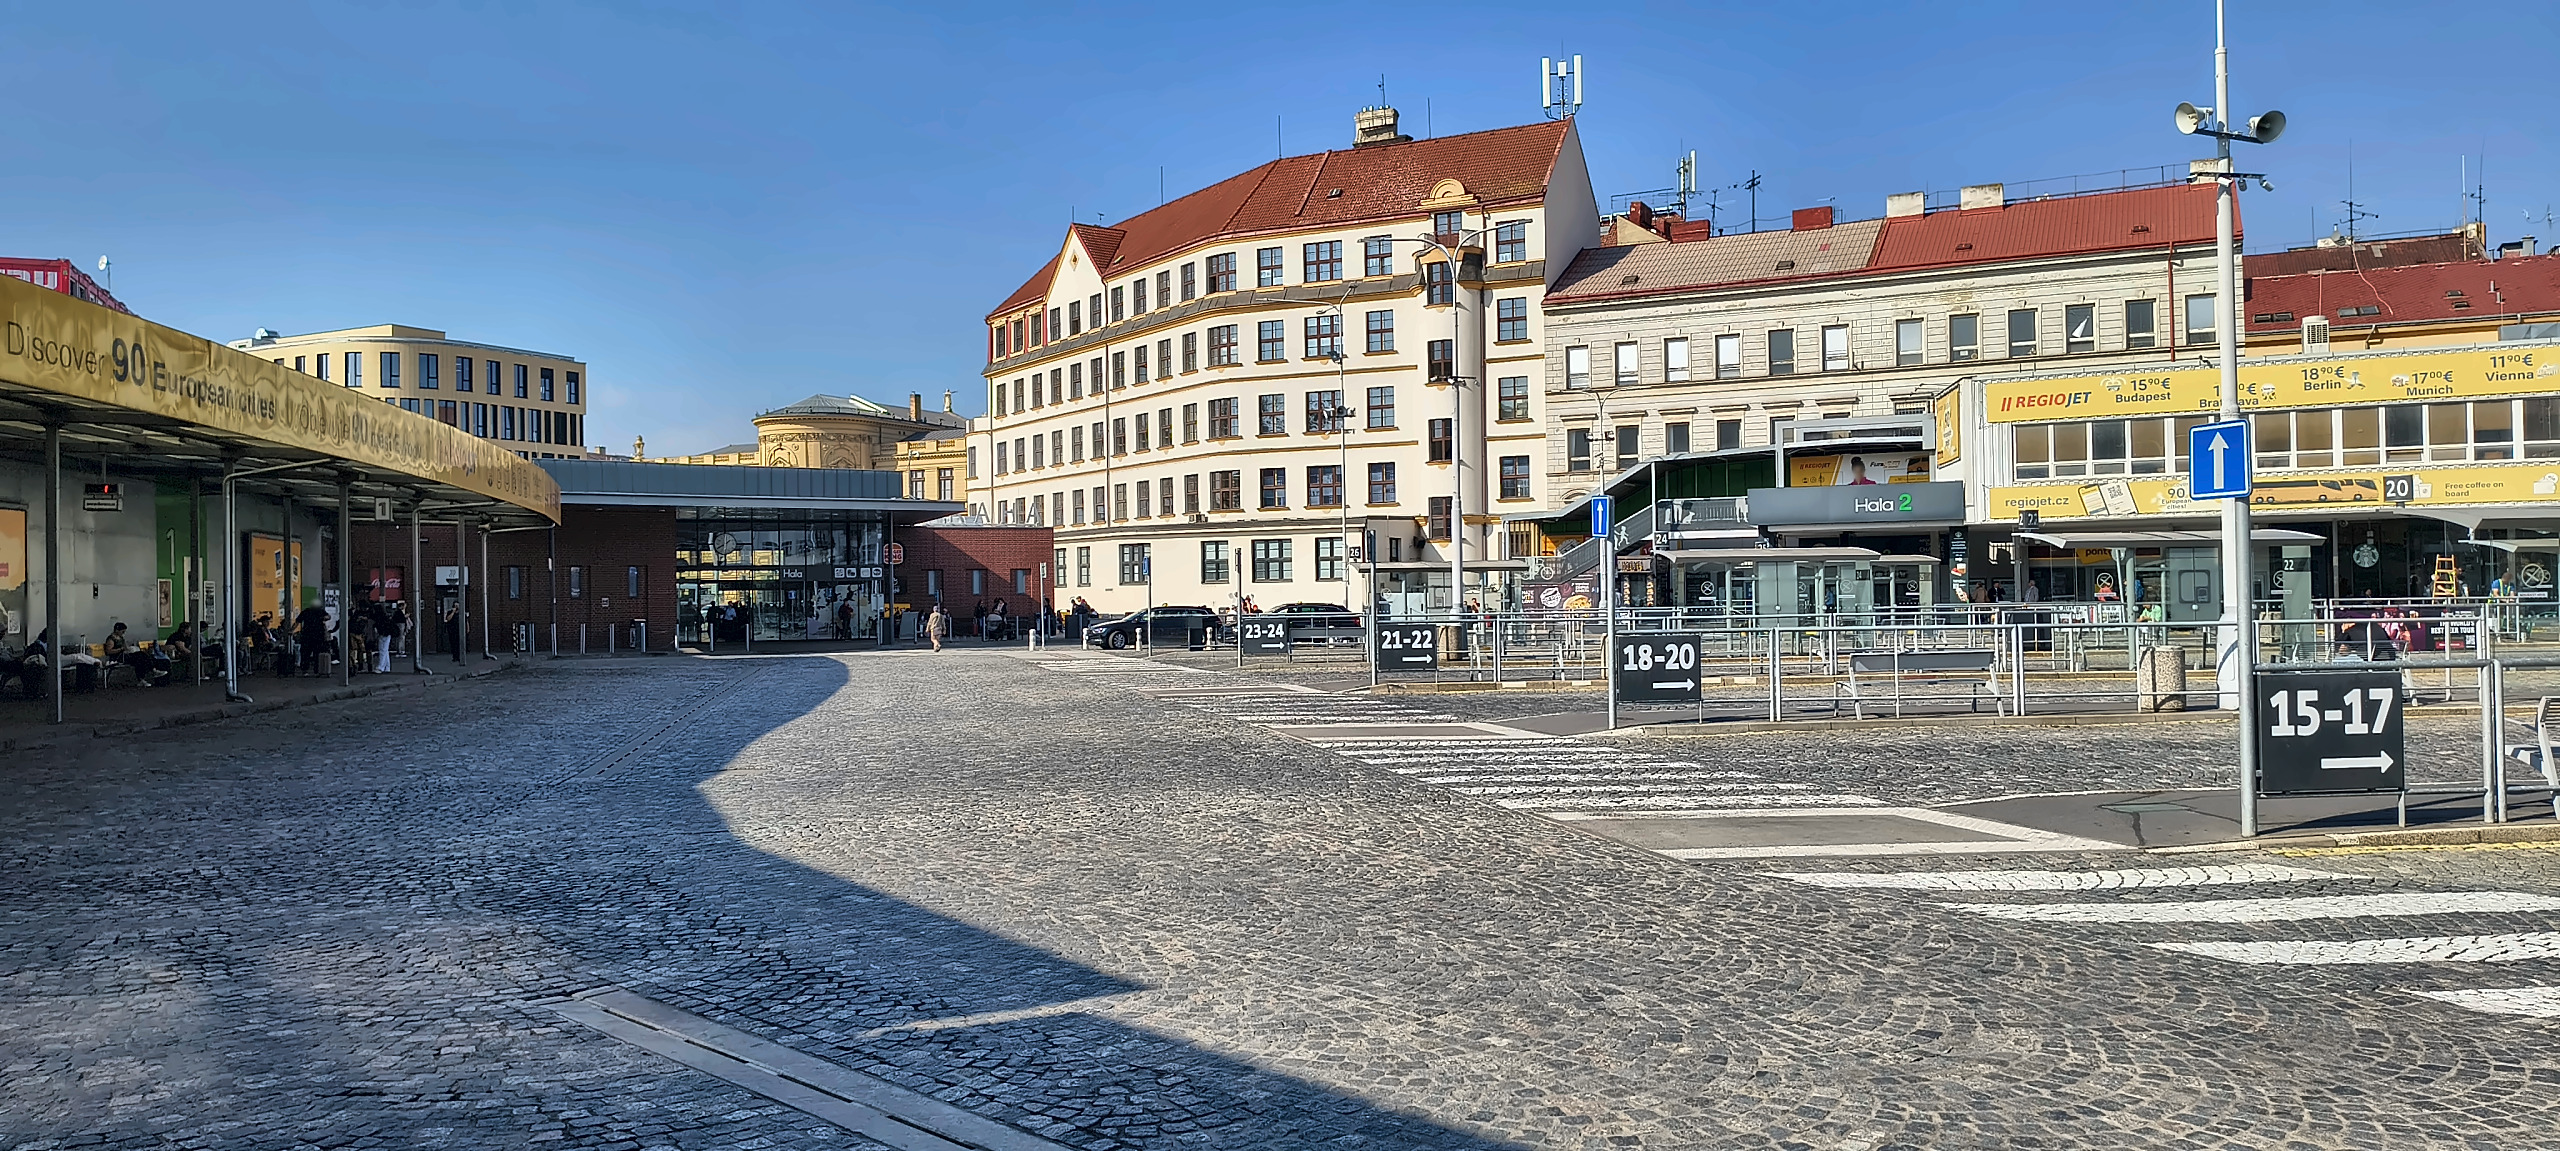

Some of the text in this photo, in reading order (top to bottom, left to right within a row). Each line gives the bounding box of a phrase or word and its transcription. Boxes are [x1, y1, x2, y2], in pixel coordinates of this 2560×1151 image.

[7, 320, 105, 377] Discover
[111, 337, 146, 387] 90
[152, 360, 234, 411] European
[2485, 370, 2534, 382] Vienna
[2303, 379, 2342, 391] Berlin
[2406, 384, 2454, 397] Munich
[2015, 391, 2092, 408] REGIOJET
[2115, 391, 2172, 404] Budapest
[2385, 479, 2409, 498] 20
[2445, 482, 2464, 490] Free
[2465, 481, 2491, 489] coffee
[2167, 487, 2185, 498] 90
[2445, 489, 2470, 497] board
[1854, 493, 1913, 513] Hala 2
[2005, 496, 2069, 508] regiojet.cz
[379, 502, 386, 516] 1
[1655, 534, 1668, 544] 24
[166, 528, 175, 574] 1
[1350, 548, 1360, 557] 26
[2284, 560, 2295, 570] 22
[783, 569, 803, 578] Hala
[1245, 623, 1285, 639] 23-24
[1381, 630, 1433, 649] 21-22
[1623, 643, 1695, 671] 18-20
[2269, 687, 2394, 737] 15-17
